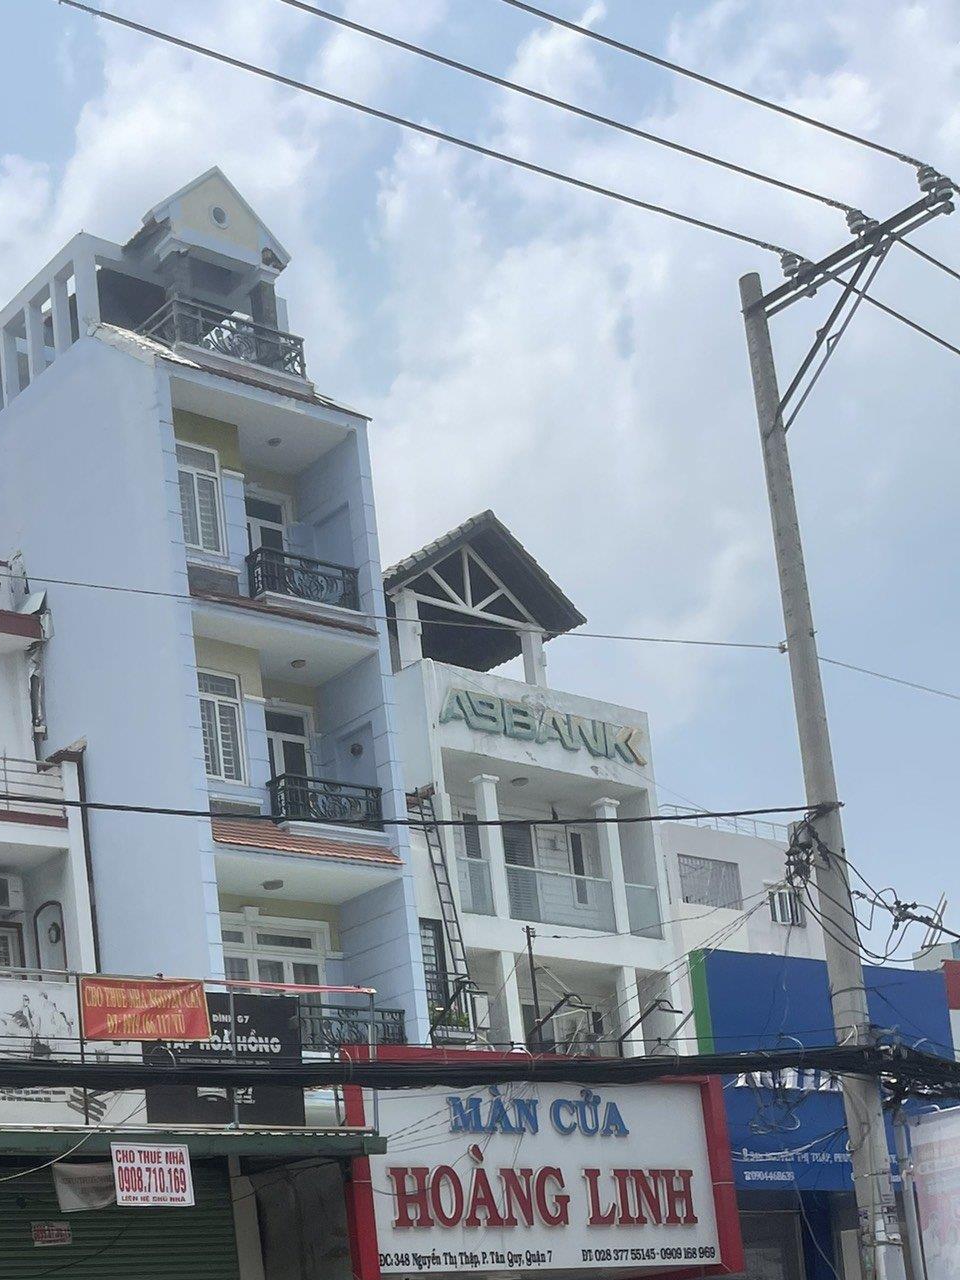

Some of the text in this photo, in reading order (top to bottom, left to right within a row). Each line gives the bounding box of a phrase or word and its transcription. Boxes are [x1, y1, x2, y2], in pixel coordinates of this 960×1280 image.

[439, 688, 647, 766] ABBANK
[237, 1015, 250, 1025] G7
[446, 1085, 630, 1137] MÀN CỬA
[115, 1149, 135, 1163] CHO
[117, 1166, 187, 1193] 0908.710.169
[387, 1143, 699, 1229] HOÀNG LINH
[394, 1253, 410, 1267] 348
[547, 1250, 553, 1263] 7
[594, 1249, 612, 1262] 028
[613, 1249, 629, 1261] 377
[698, 1246, 716, 1259] 969
